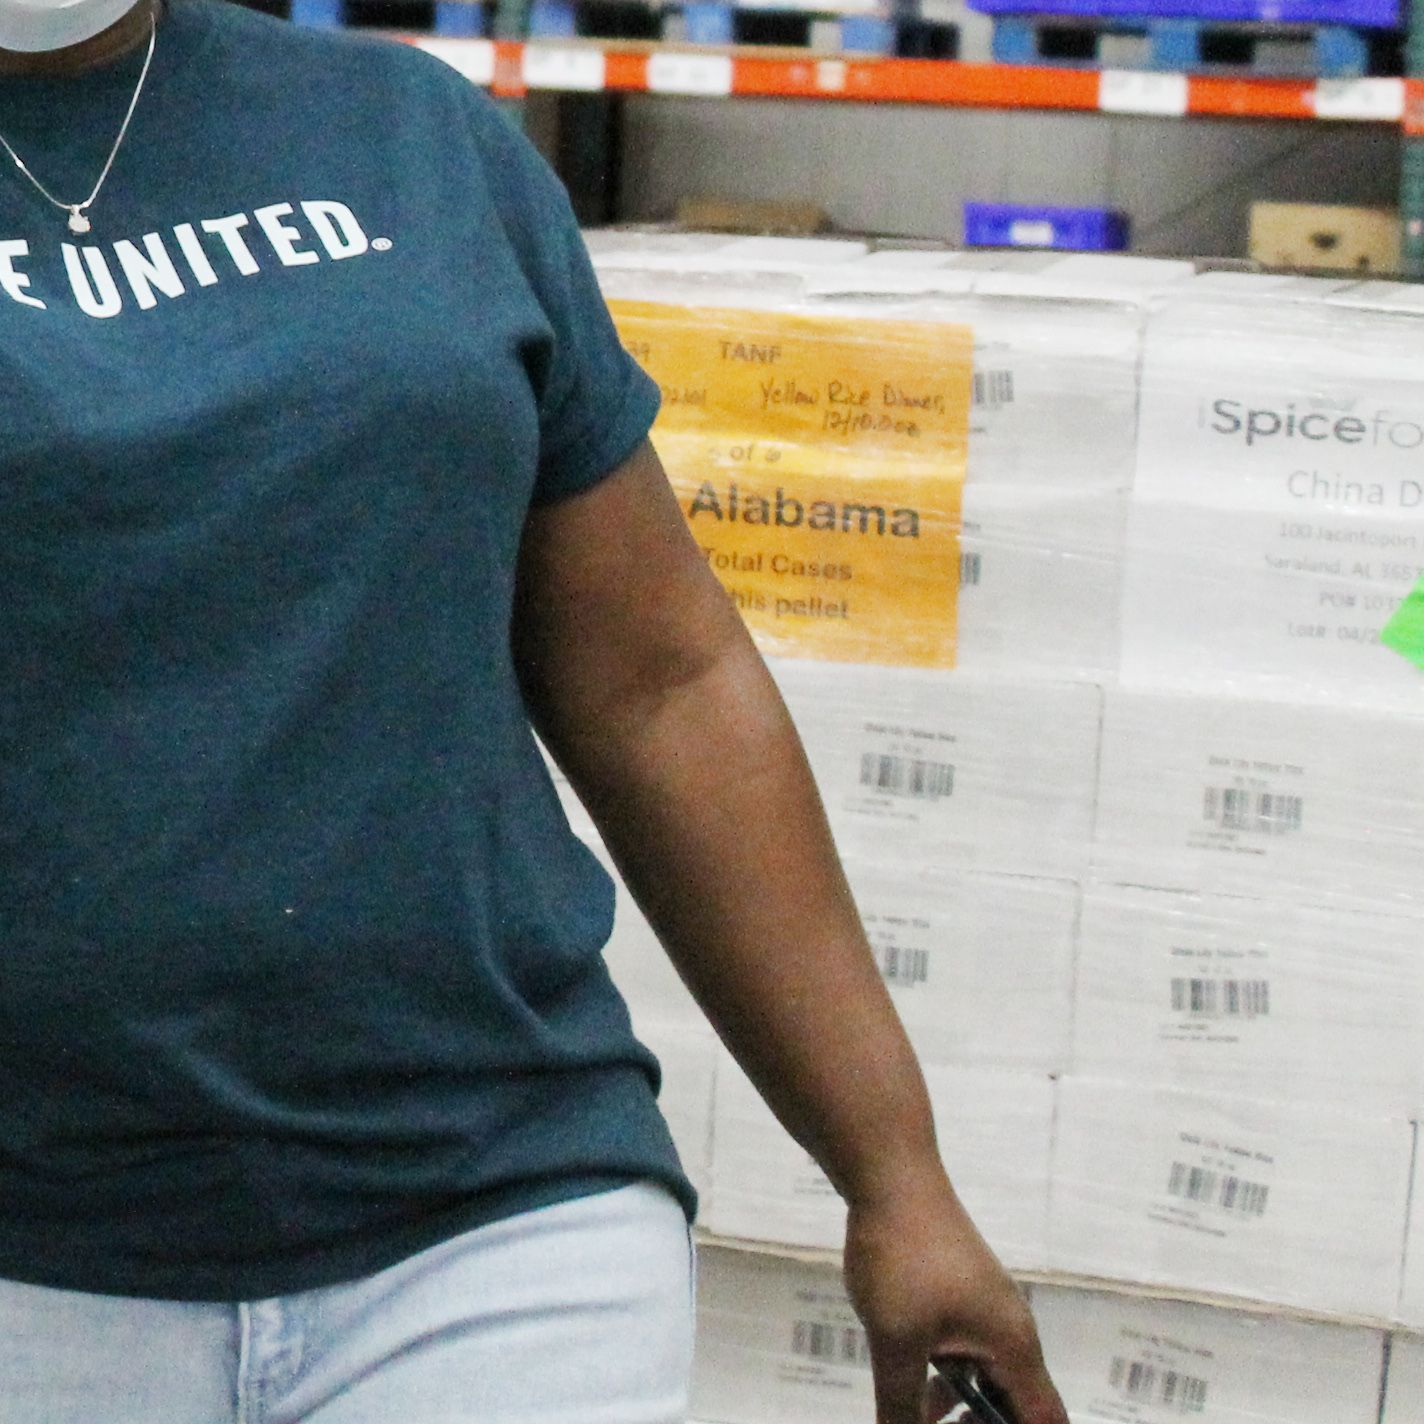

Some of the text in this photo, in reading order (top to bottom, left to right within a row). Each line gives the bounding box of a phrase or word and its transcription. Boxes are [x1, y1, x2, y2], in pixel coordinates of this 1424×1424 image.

[718, 341, 782, 365] TANF
[760, 377, 817, 409] Yellow
[827, 378, 870, 406] Rice
[1287, 469, 1384, 506] China
[688, 480, 920, 538] Alabama
[703, 547, 853, 581] Total Cases
[775, 595, 849, 620] pallet
